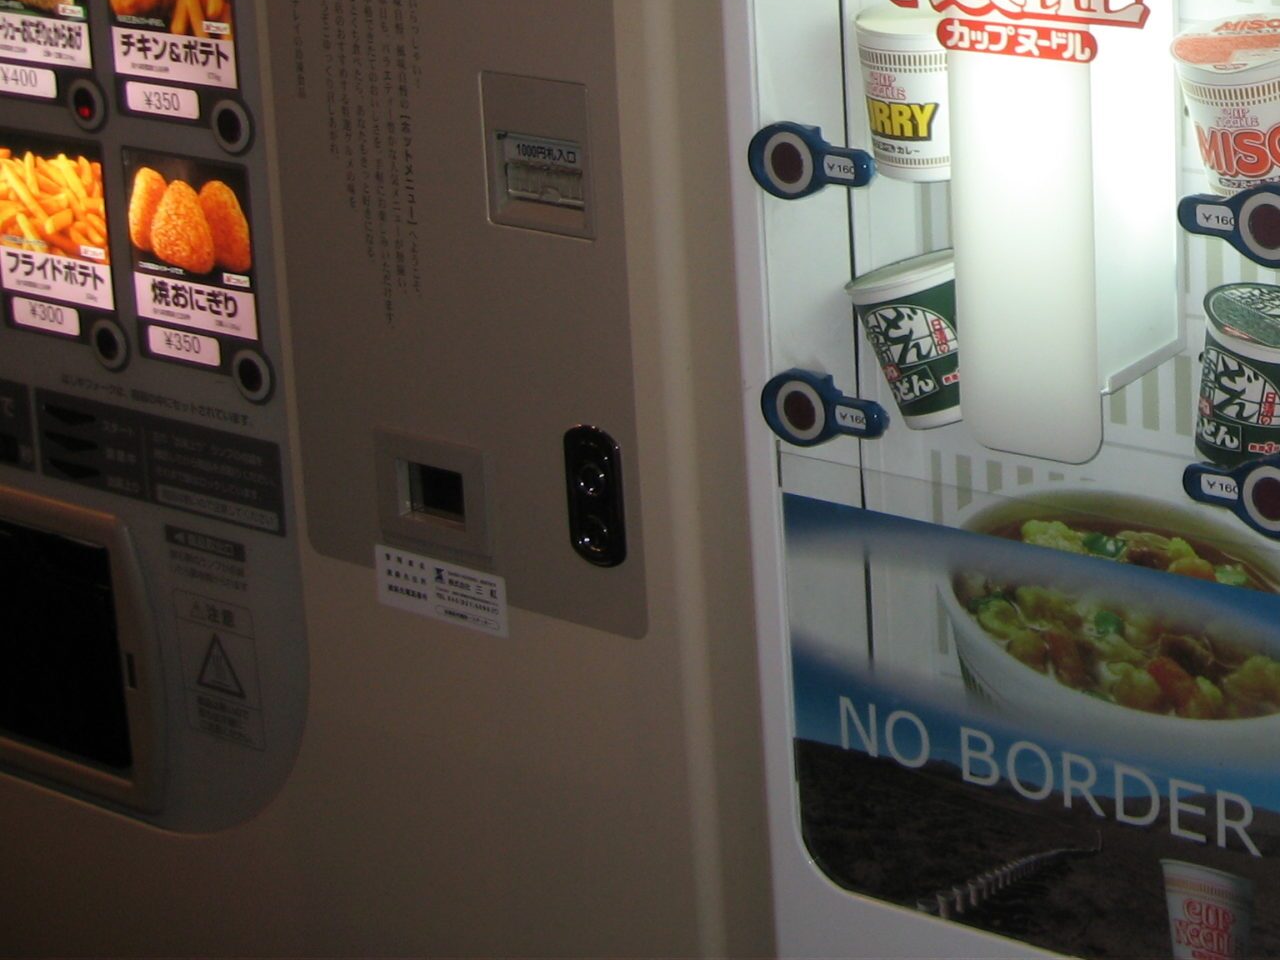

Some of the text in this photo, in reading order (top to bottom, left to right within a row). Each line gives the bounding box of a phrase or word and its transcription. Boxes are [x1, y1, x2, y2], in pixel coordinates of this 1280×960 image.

[120, 33, 229, 70] チキン&ポテト
[946, 20, 1091, 60] カップヌードル
[1, 67, 38, 88] ¥400
[144, 92, 181, 112] ¥350
[896, 145, 921, 155] カレー
[6, 252, 104, 290] フライドポテト
[28, 302, 64, 325] ¥300
[151, 279, 239, 318] 焼おにぎり
[164, 332, 201, 354] ¥350
[839, 695, 1263, 858] NO BORDER
[1183, 898, 1237, 930] CUP
